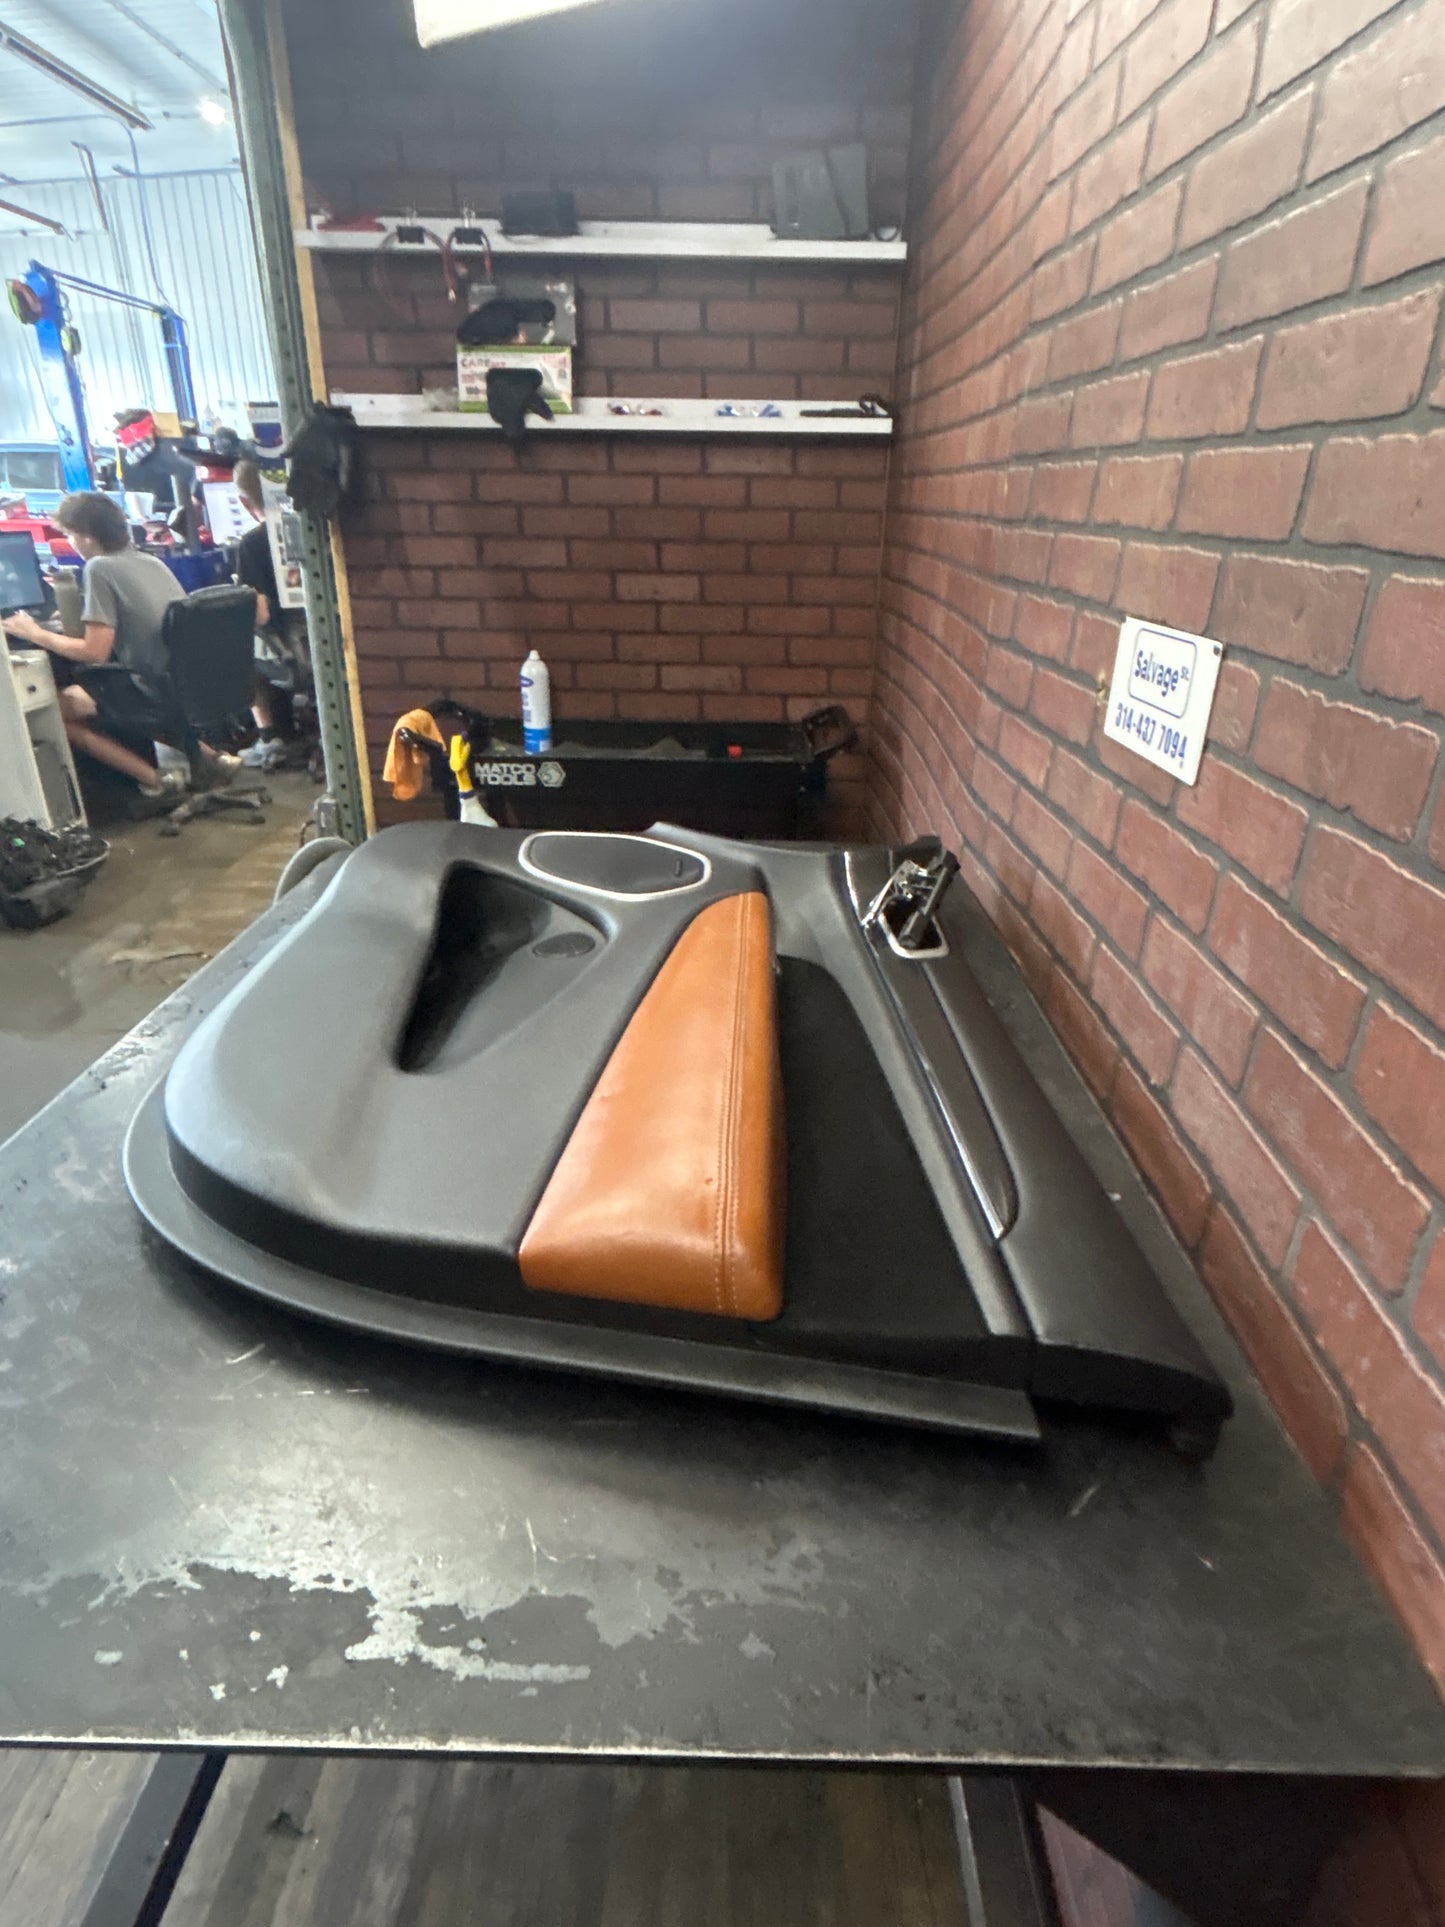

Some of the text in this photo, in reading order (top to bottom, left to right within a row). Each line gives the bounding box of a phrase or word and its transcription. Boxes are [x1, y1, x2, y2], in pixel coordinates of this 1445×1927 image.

[1134, 650, 1179, 697] Salvage
[1115, 702, 1188, 766] 314-437 7094
[474, 762, 536, 774] MATCO
[478, 774, 537, 785] TOOLS
